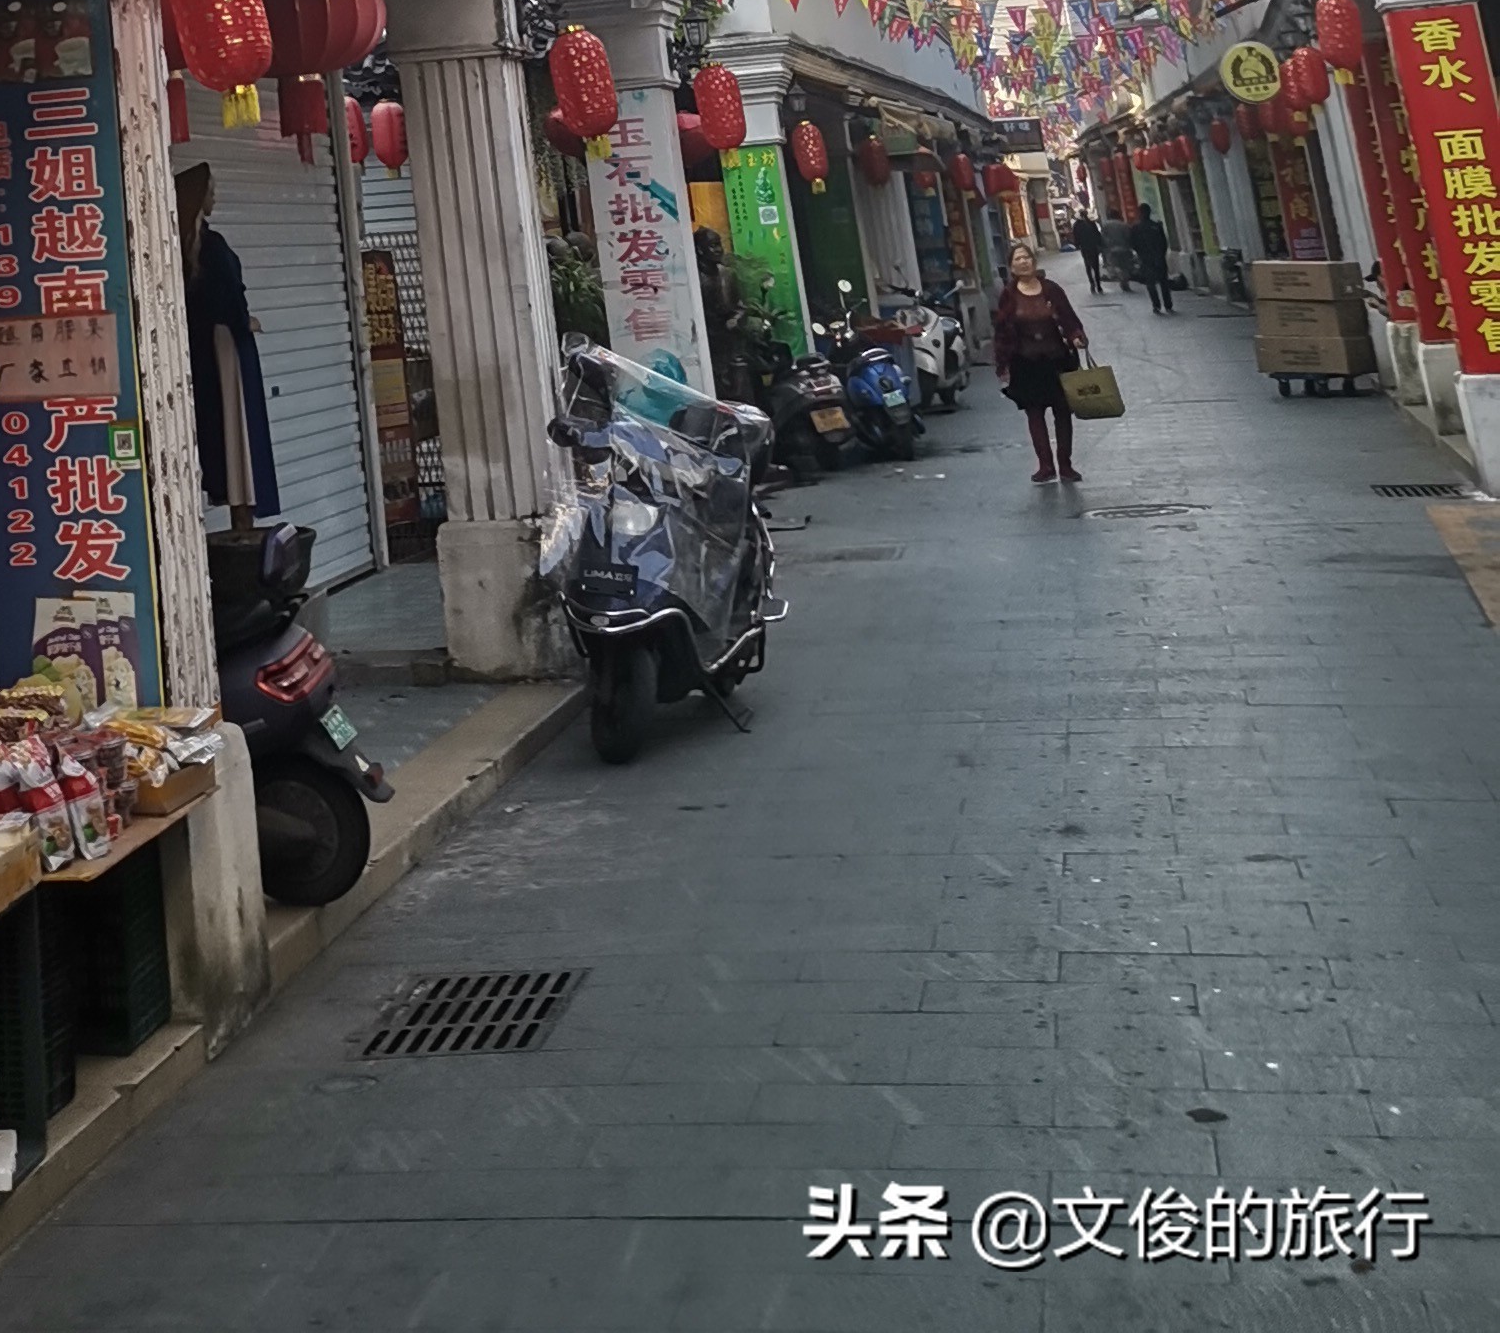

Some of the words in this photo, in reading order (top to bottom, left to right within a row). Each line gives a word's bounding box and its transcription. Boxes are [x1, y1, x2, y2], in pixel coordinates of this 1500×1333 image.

[24, 86, 130, 582] 三姐越南产批发
[603, 117, 672, 343] 玉石批发零售
